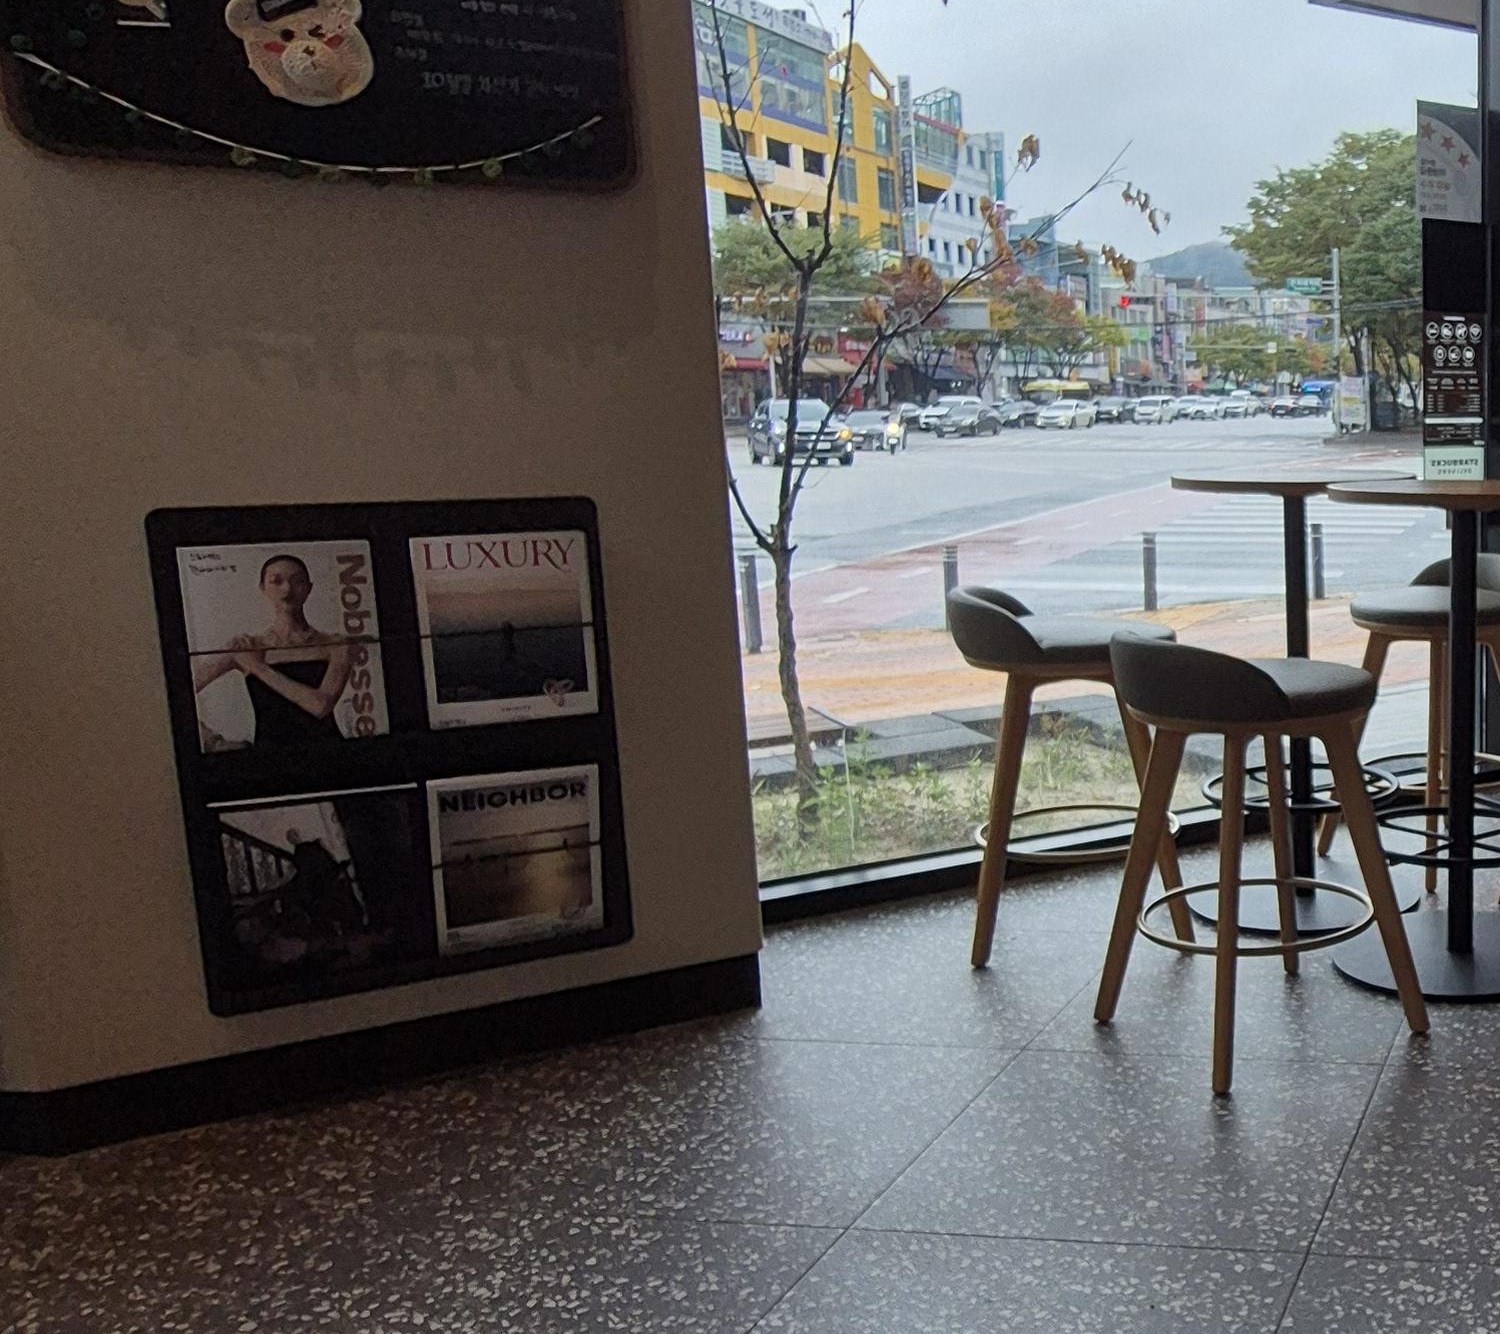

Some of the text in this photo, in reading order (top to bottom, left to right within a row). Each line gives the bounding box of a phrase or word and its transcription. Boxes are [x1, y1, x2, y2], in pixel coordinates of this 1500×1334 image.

[422, 536, 577, 573] LUXURY
[336, 553, 377, 738] Nobesse
[439, 781, 588, 814] NEIGHBOR
